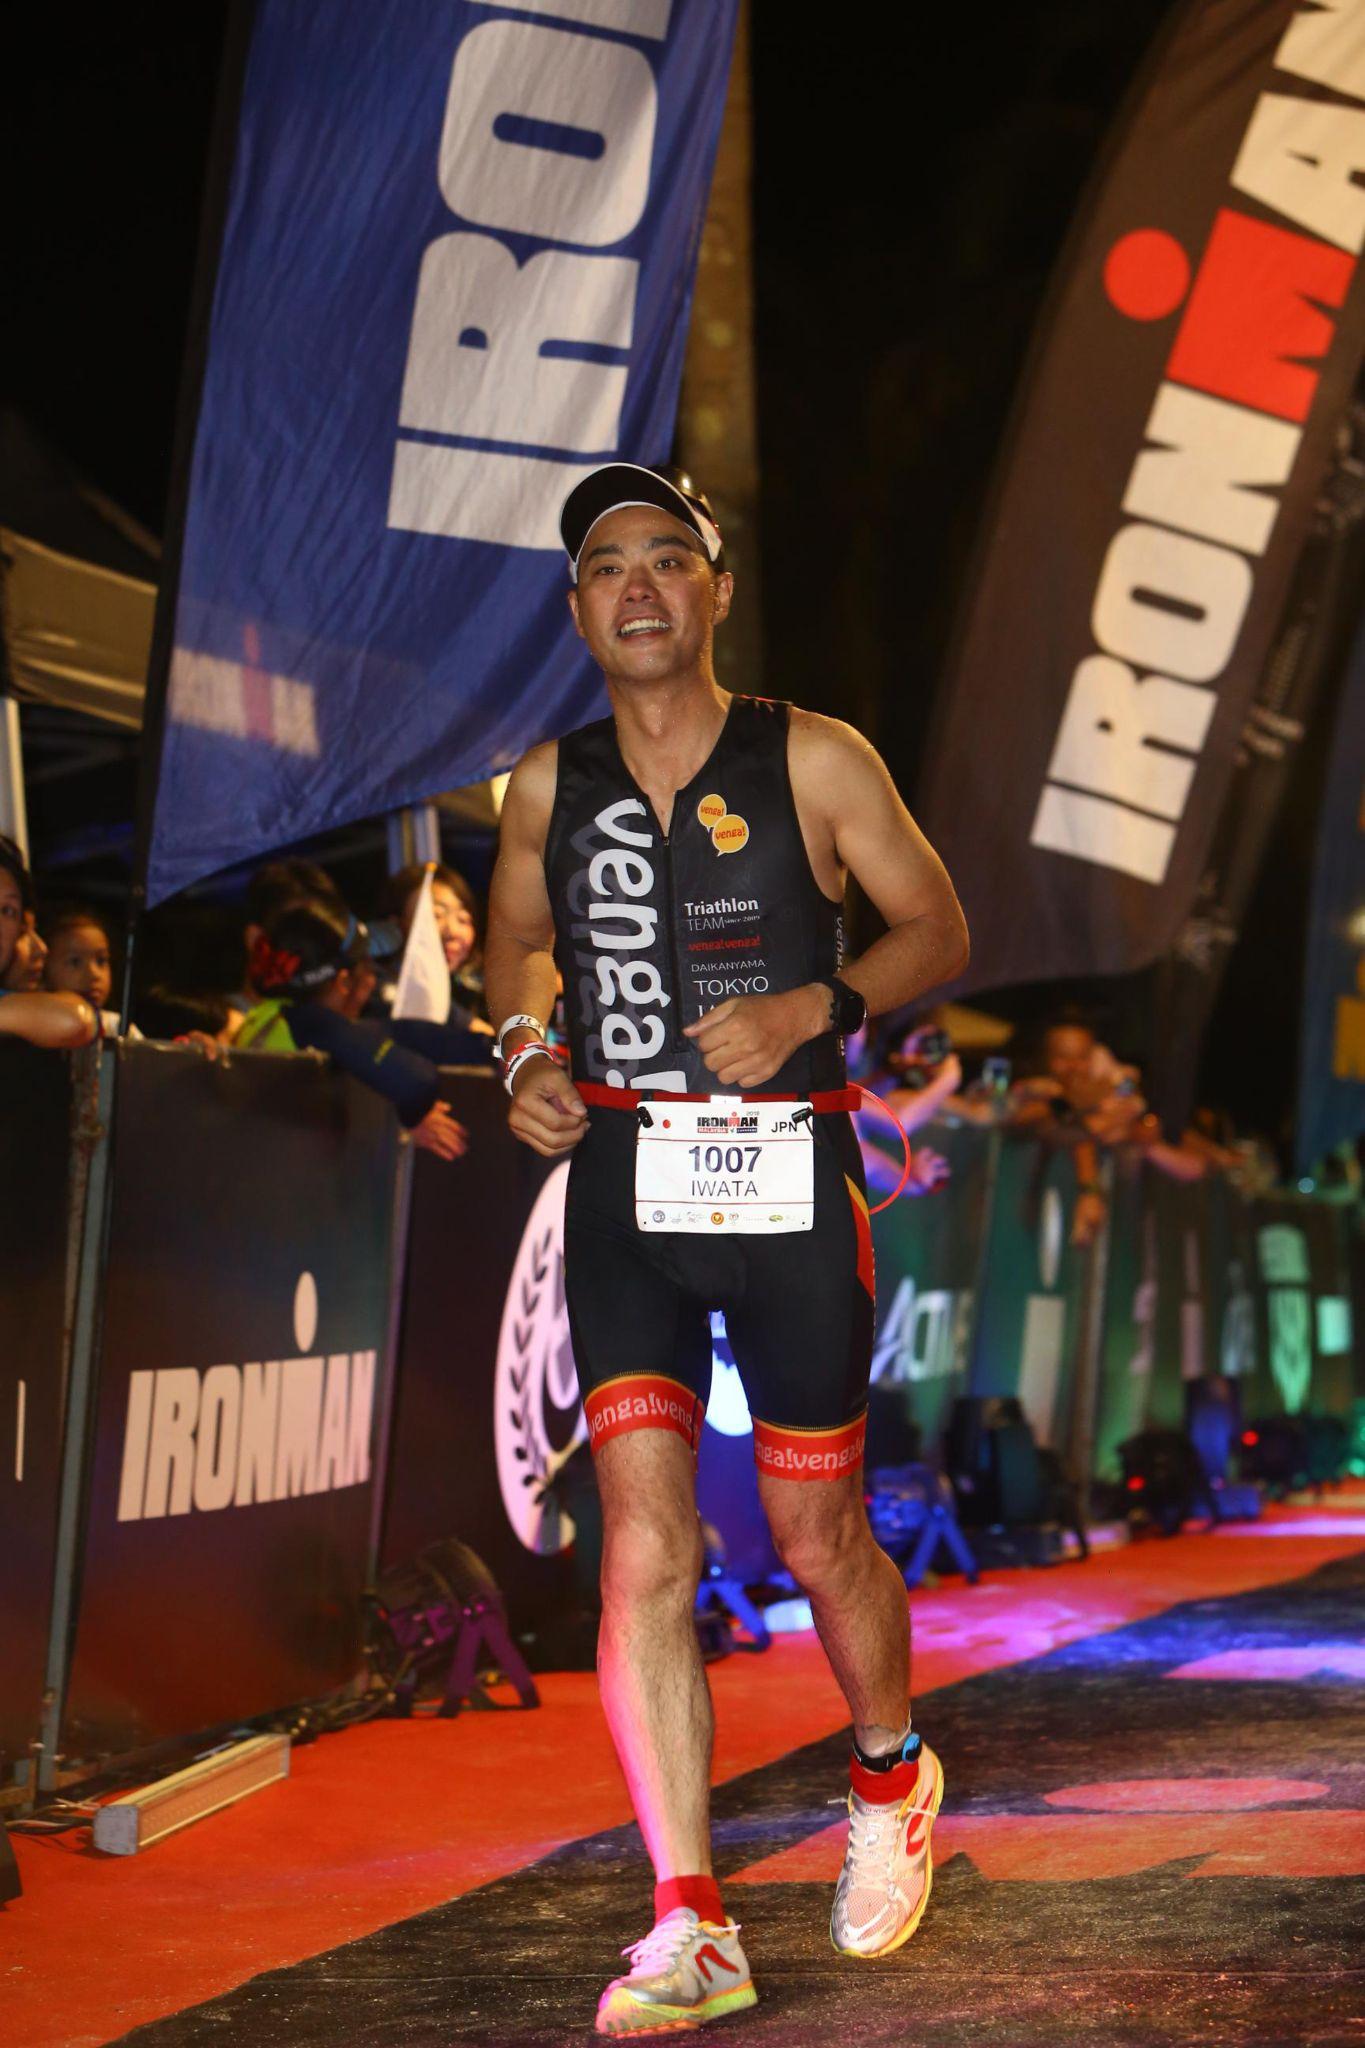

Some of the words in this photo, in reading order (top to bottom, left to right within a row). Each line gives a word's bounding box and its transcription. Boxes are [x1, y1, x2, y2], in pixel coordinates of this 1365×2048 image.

[387, 0, 668, 550] IRO
[715, 826, 746, 840] venga!
[684, 897, 759, 916] Triathlon
[687, 917, 725, 931] TEAM
[588, 798, 688, 1094] venga!
[691, 959, 766, 972] DAIKANYAMA
[692, 976, 769, 995] TOKYO
[697, 1116, 758, 1127] IRONMAN
[771, 1121, 798, 1133] JPN
[688, 1146, 763, 1174] 1007
[691, 1180, 759, 1197] IWATA
[117, 1350, 377, 1522] IRONMAN
